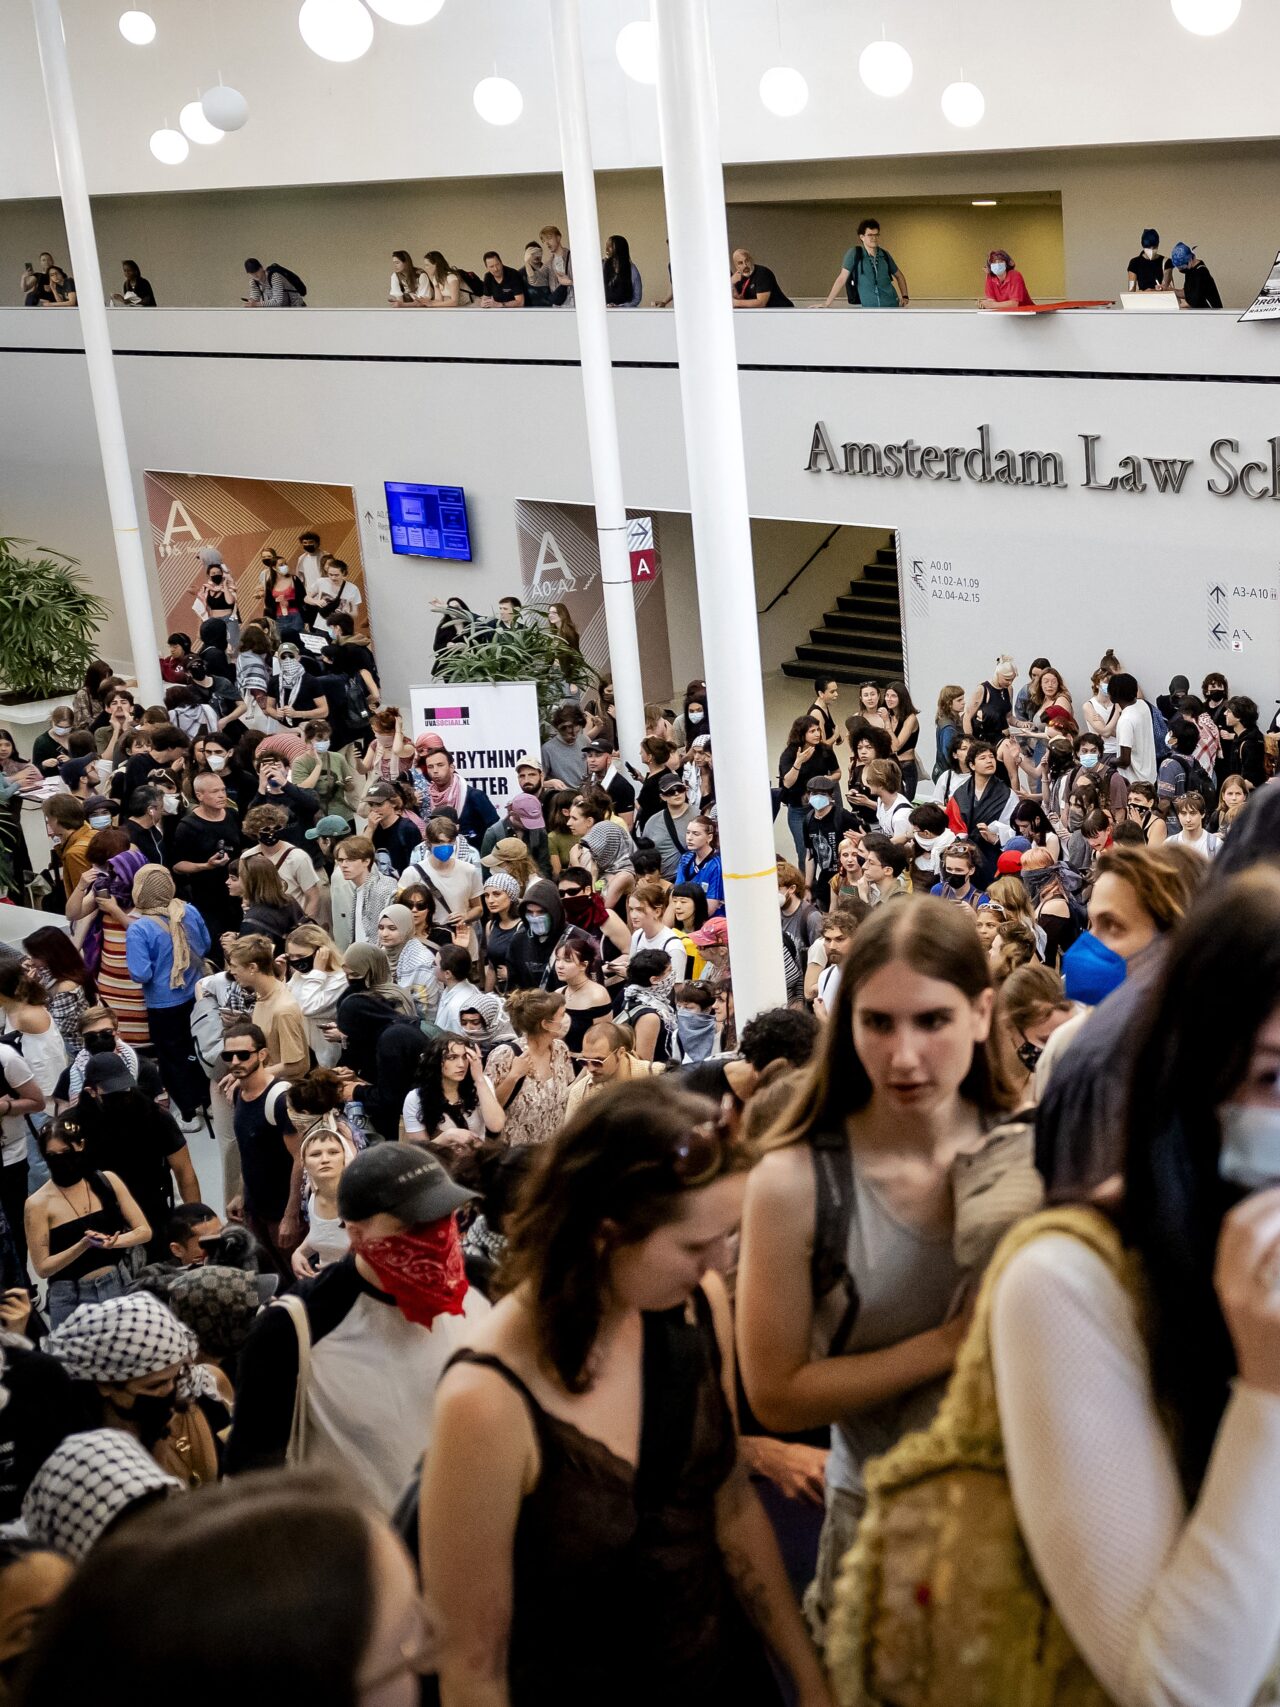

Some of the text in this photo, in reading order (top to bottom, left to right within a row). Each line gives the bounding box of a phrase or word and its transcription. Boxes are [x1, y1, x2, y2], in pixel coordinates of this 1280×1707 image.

[803, 420, 1068, 488] Amsterdam
[1077, 434, 1194, 493] Law
[163, 499, 202, 544] A
[532, 530, 574, 585] A
[637, 558, 651, 576] A
[930, 560, 952, 571] A0.01
[532, 577, 578, 598] A0-A2
[931, 575, 979, 588] A1.02-A1.09
[932, 590, 980, 602] A2.04-A2.15
[1233, 586, 1268, 599] A3-A10
[1233, 629, 1241, 639] A
[424, 719, 470, 727] UVASOCIAAL.NL
[465, 777, 508, 795] TTER
